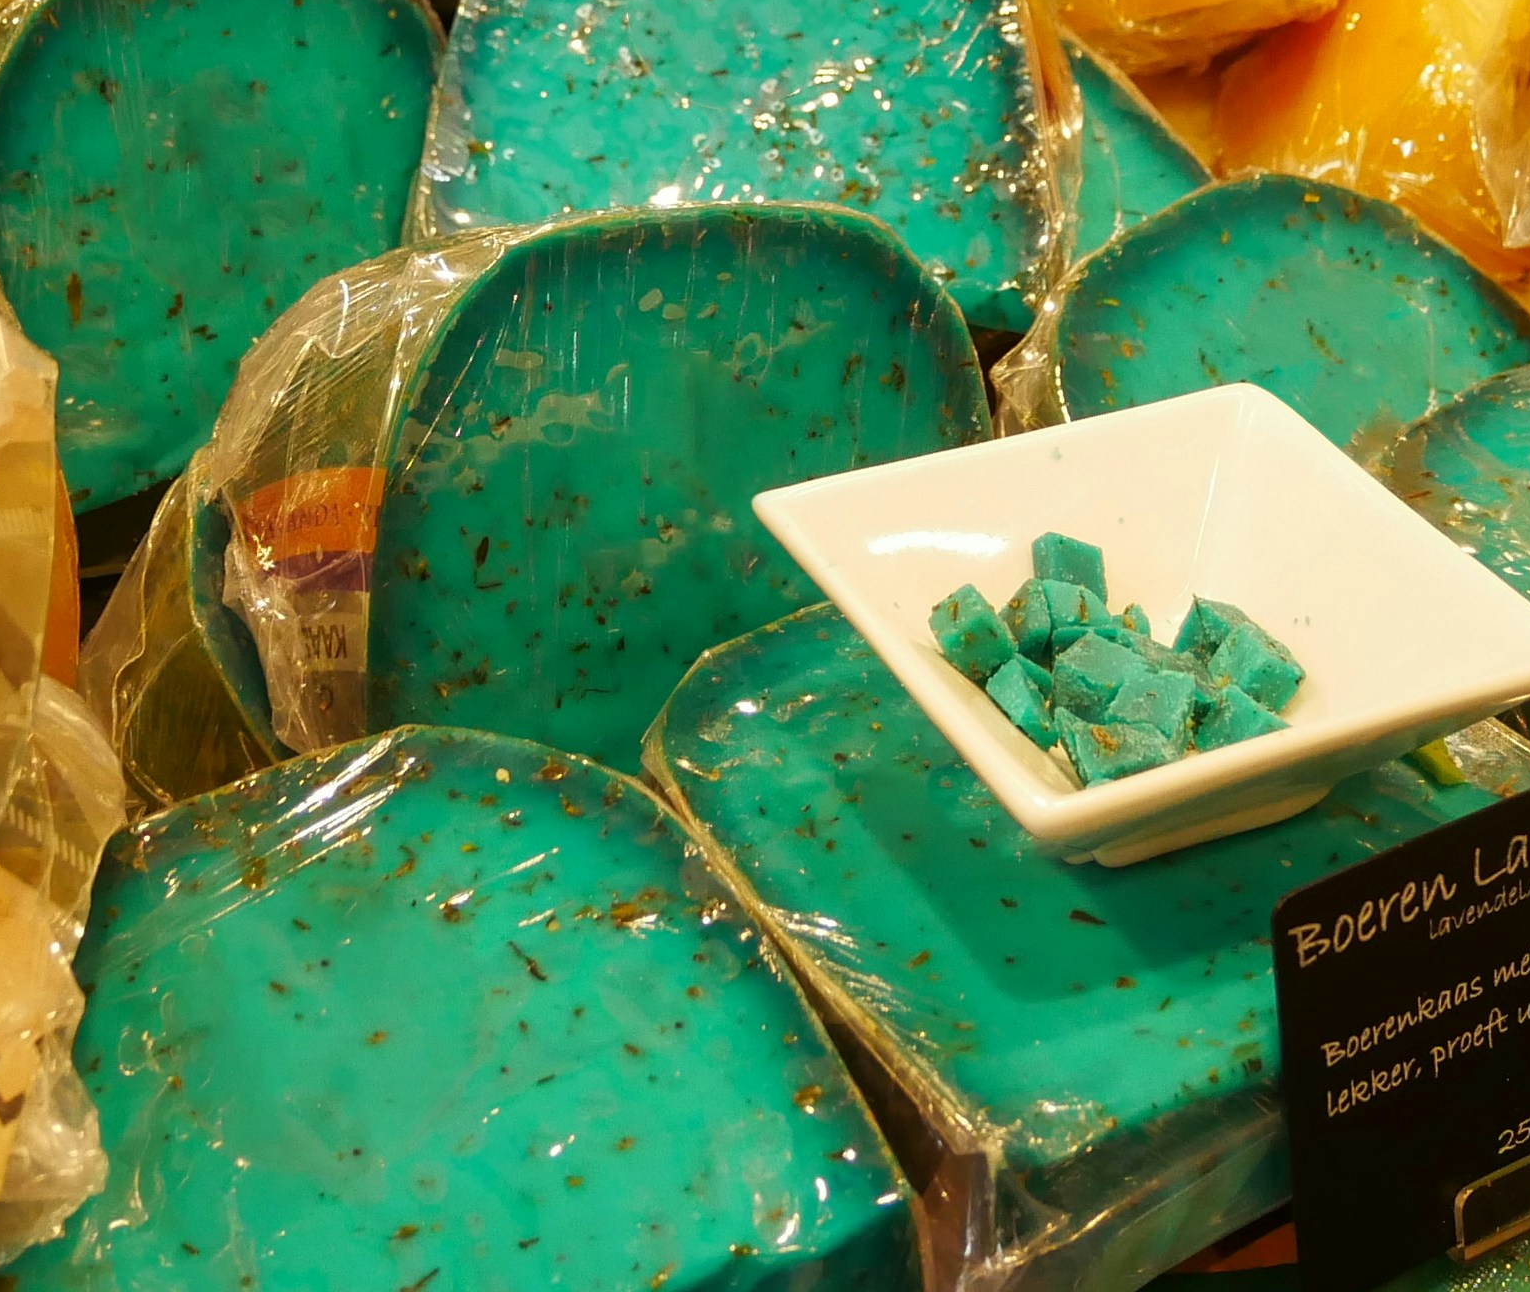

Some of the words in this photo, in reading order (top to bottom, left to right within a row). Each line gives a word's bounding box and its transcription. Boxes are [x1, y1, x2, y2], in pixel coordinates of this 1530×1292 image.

[1287, 872, 1458, 969] Boeren
[1321, 975, 1484, 1067] Boerenkaas
[1326, 1057, 1423, 1118] lekker,
[1429, 1007, 1509, 1079] proeft
